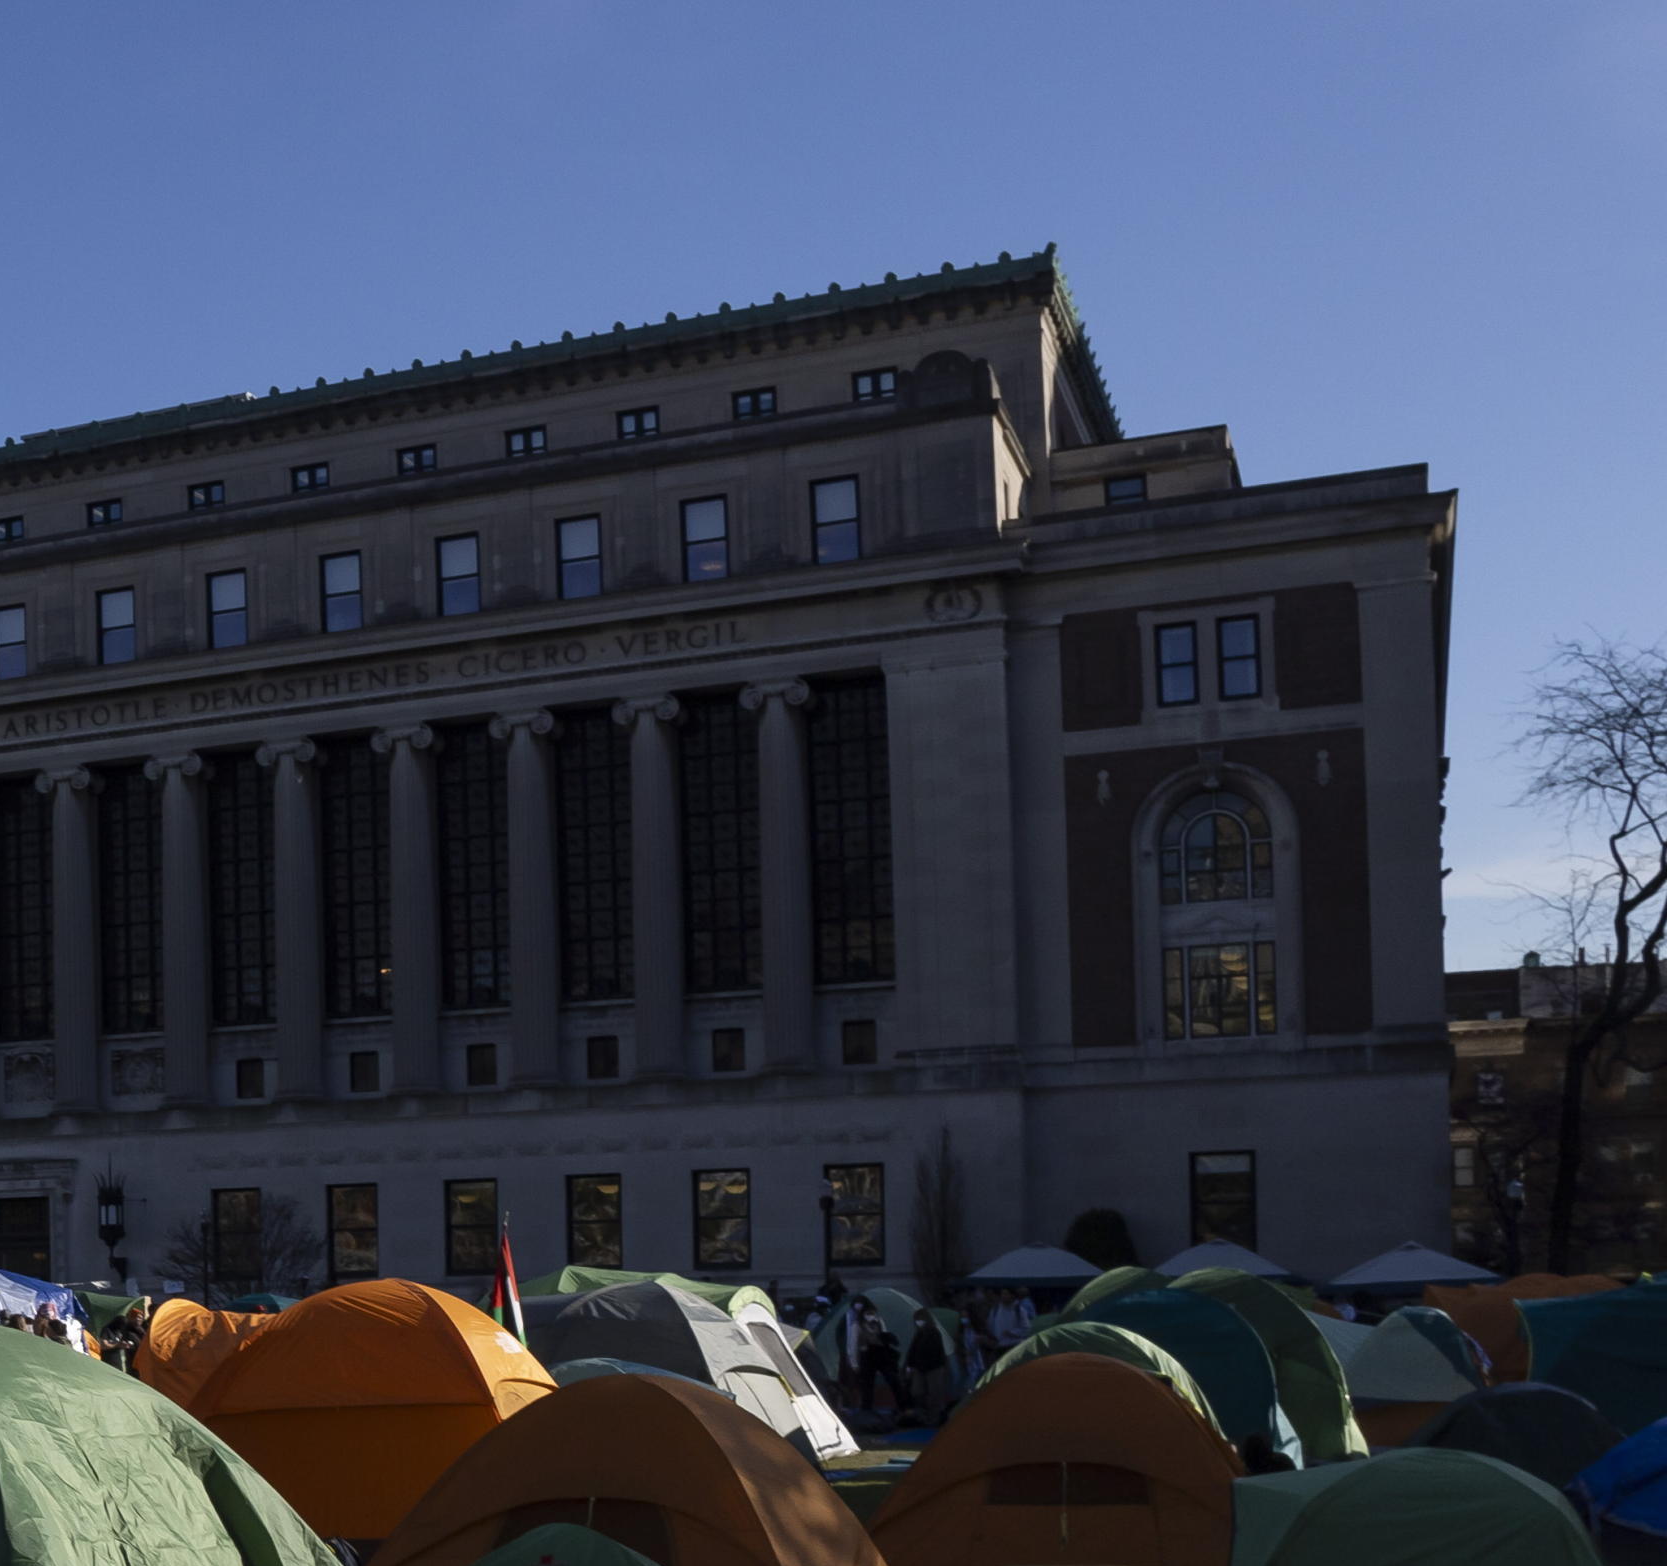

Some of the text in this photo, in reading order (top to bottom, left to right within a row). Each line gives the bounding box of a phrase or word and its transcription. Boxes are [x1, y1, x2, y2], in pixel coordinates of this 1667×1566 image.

[4, 696, 167, 739] ARISTOTLE
[190, 662, 429, 713] DEMOSTHENES
[458, 640, 586, 679] CICERO
[616, 620, 747, 657] VERGIL
